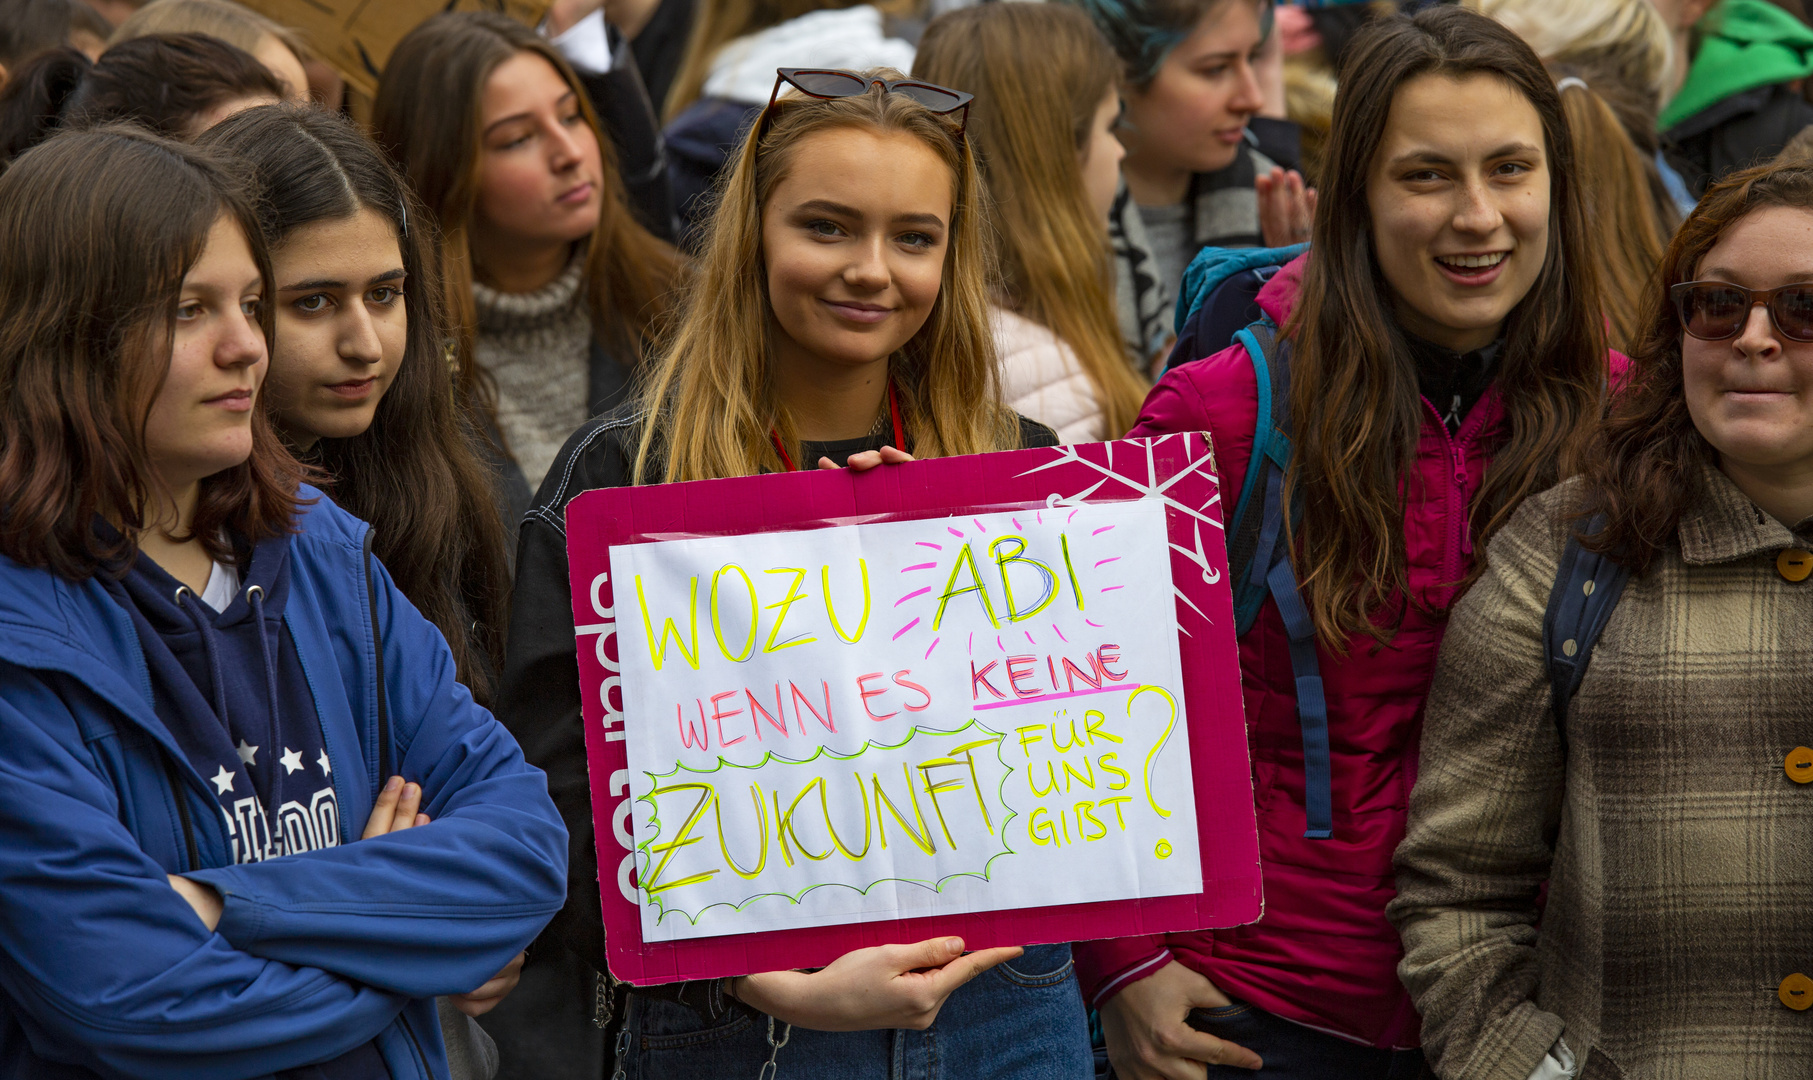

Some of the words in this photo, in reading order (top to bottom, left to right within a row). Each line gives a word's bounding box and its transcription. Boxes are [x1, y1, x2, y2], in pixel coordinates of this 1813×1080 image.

[635, 558, 871, 671] WOZU
[932, 531, 1085, 632] ABI
[677, 679, 838, 752] WENN
[856, 669, 932, 722] ES
[970, 643, 1129, 700] KEINE
[1014, 708, 1124, 758] FÜR
[1027, 751, 1131, 799] UNS
[647, 737, 1000, 895] ZUKUNFT
[1027, 795, 1133, 849] GIBT
